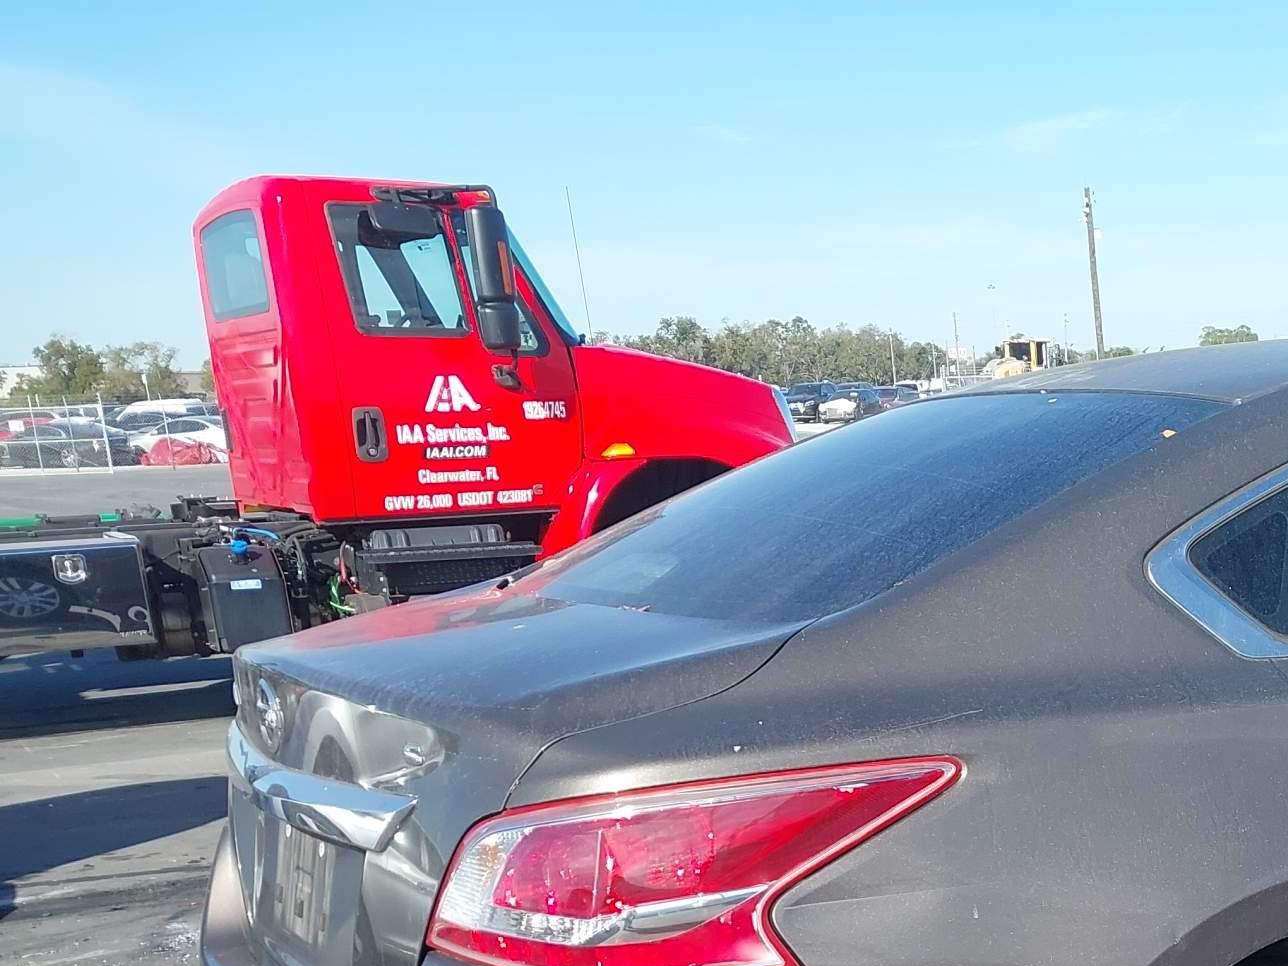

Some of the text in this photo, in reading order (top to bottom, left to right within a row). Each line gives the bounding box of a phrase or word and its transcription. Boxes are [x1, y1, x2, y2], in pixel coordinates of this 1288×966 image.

[396, 422, 511, 444] IAA Services, Inc.
[426, 445, 487, 459] IAAI.COM
[417, 466, 500, 484] Clearwater, FL
[384, 495, 415, 511] GVW
[416, 493, 454, 510] 26,000
[457, 490, 494, 507] USDOT
